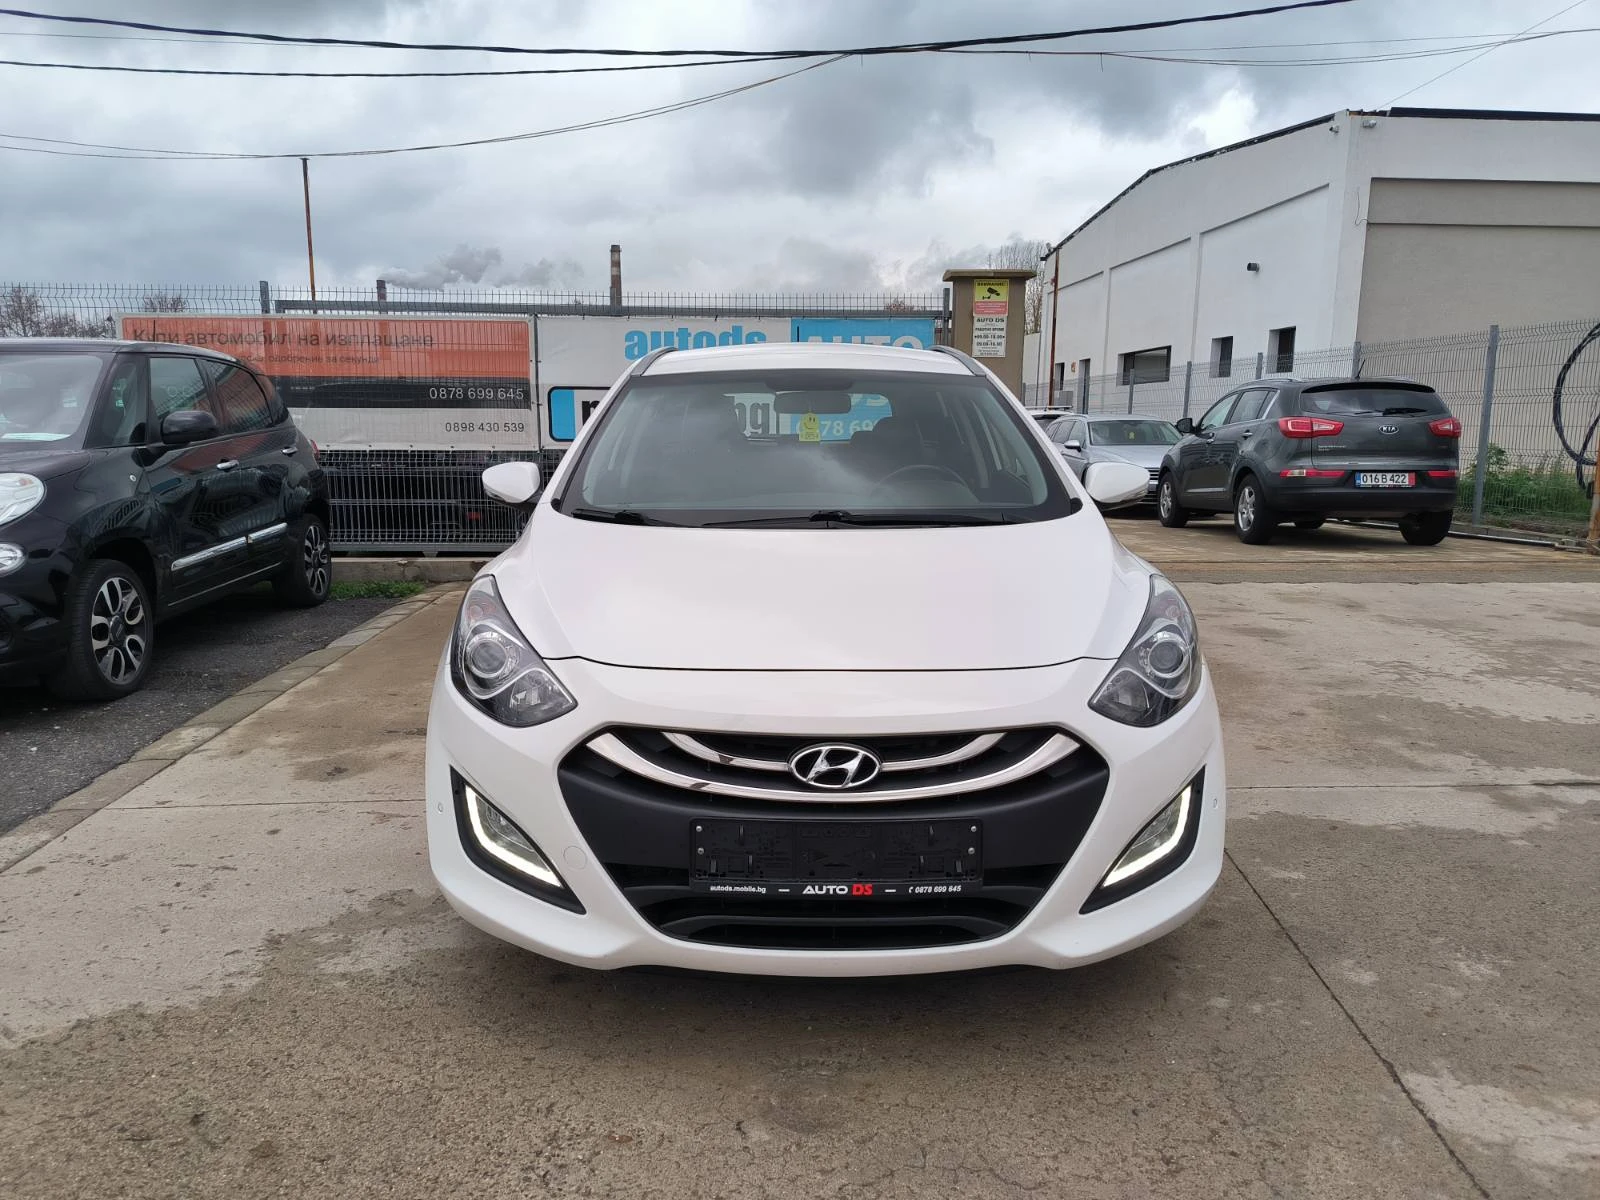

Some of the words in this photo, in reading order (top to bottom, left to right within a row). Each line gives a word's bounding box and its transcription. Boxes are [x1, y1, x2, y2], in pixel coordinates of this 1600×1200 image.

[187, 330, 288, 346] автомобил
[299, 334, 320, 346] на
[429, 387, 464, 400] 0878
[467, 387, 494, 400] 699
[497, 388, 524, 400] 645
[445, 422, 475, 433] 0898
[478, 422, 500, 433] 430
[503, 422, 525, 433] 539
[1361, 473, 1379, 484] 016
[1381, 473, 1388, 484] B
[1389, 473, 1407, 484] 422
[709, 885, 767, 894] autods.mobile.bg
[802, 885, 849, 895] AUTO
[851, 884, 873, 896] DS
[914, 885, 932, 894] 0878
[933, 885, 947, 893] 699
[948, 884, 962, 893] 645
